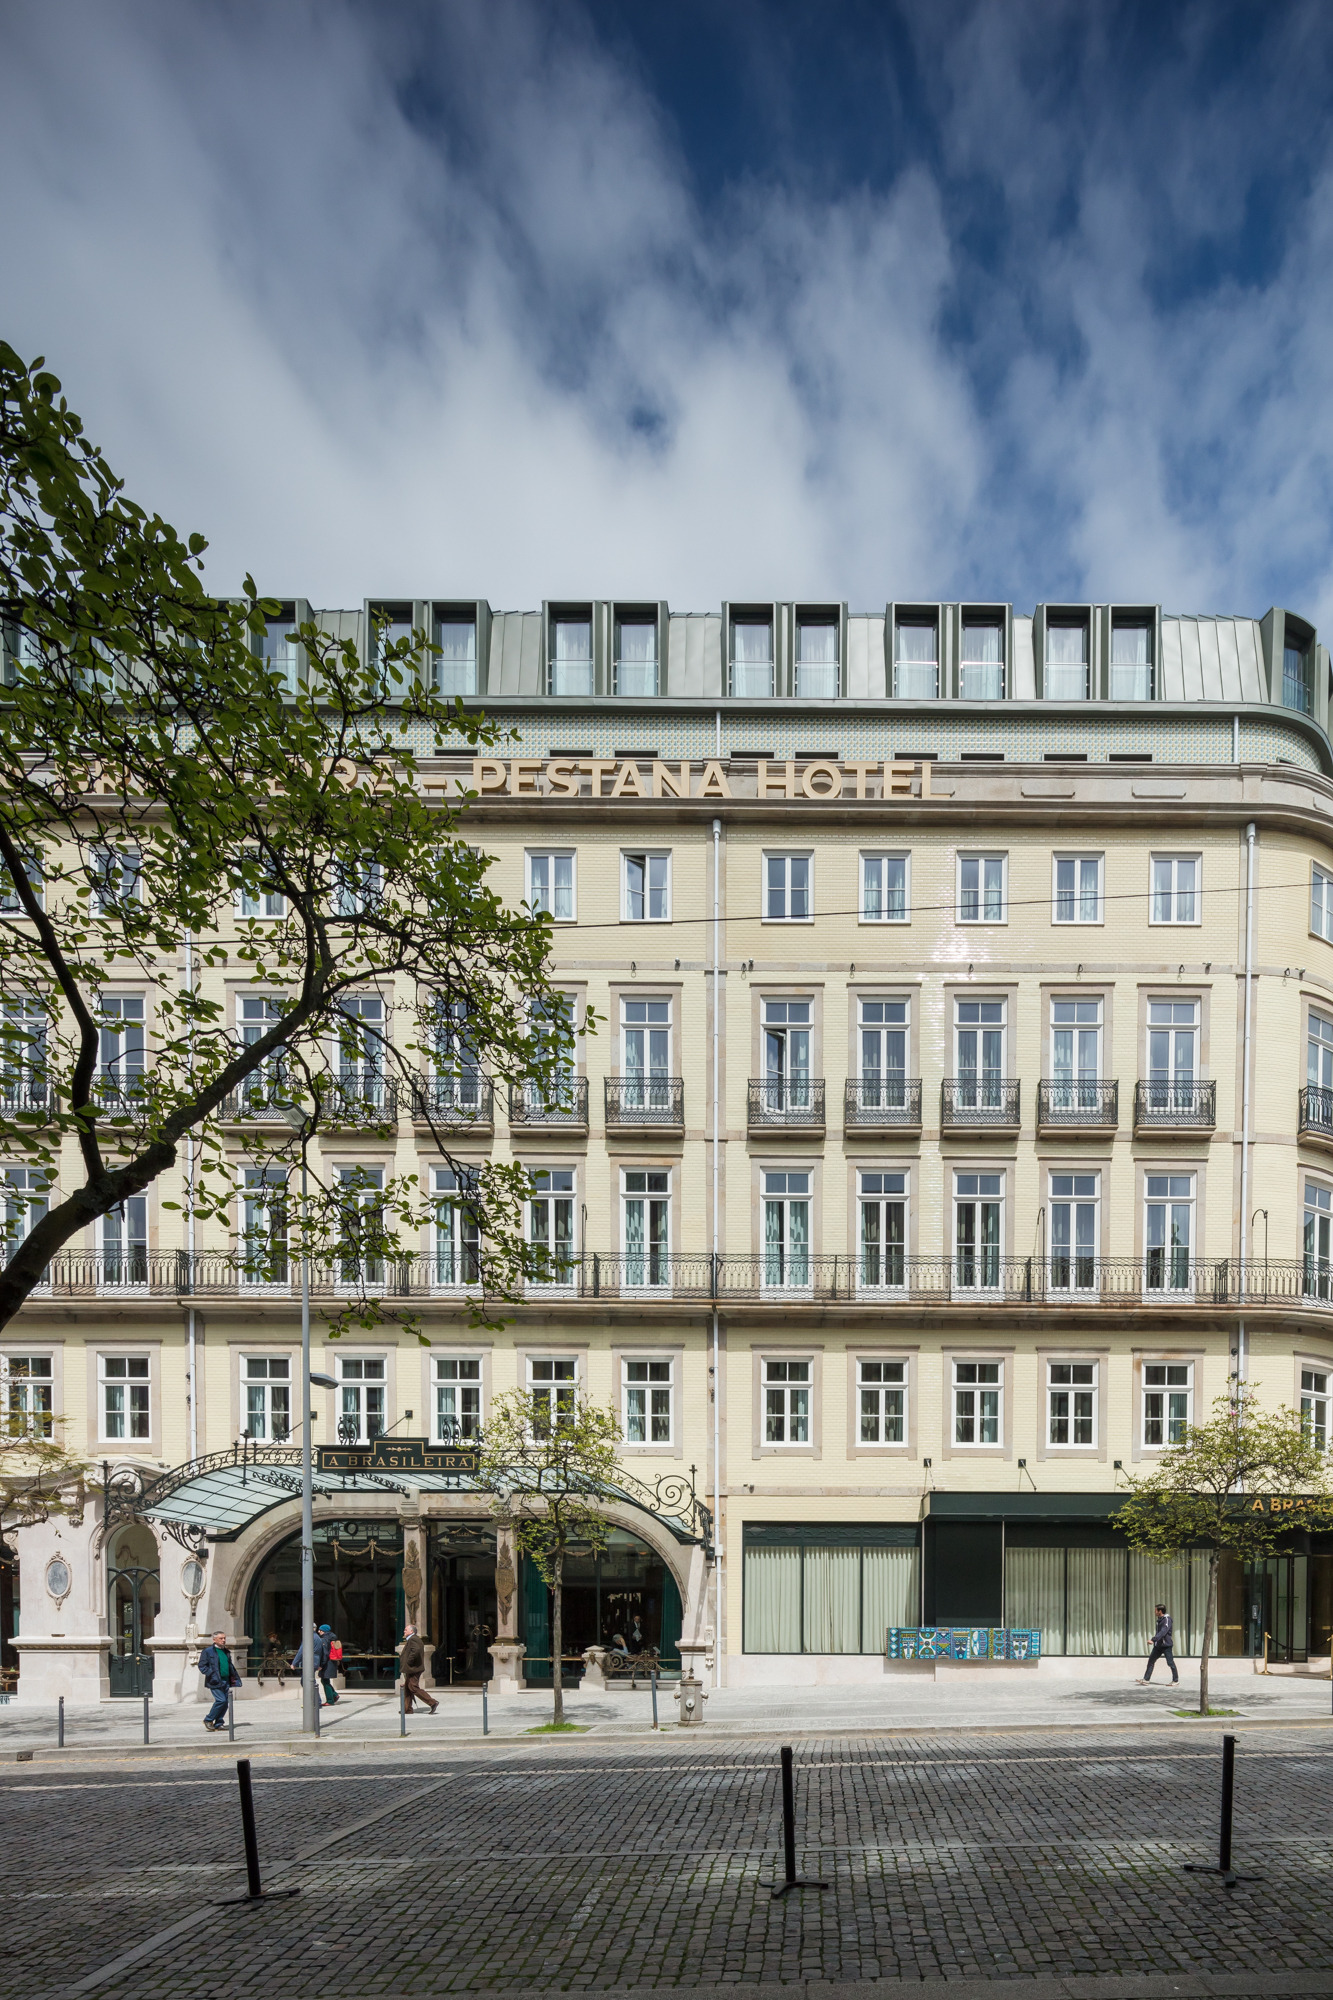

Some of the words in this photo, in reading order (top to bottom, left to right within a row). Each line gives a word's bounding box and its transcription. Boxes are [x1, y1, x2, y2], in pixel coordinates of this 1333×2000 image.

[472, 758, 733, 798] PESTANA
[757, 760, 953, 799] HOTEL
[329, 1456, 339, 1466] A
[348, 1456, 469, 1467] BRASILEIRA
[1251, 1499, 1265, 1511] A
